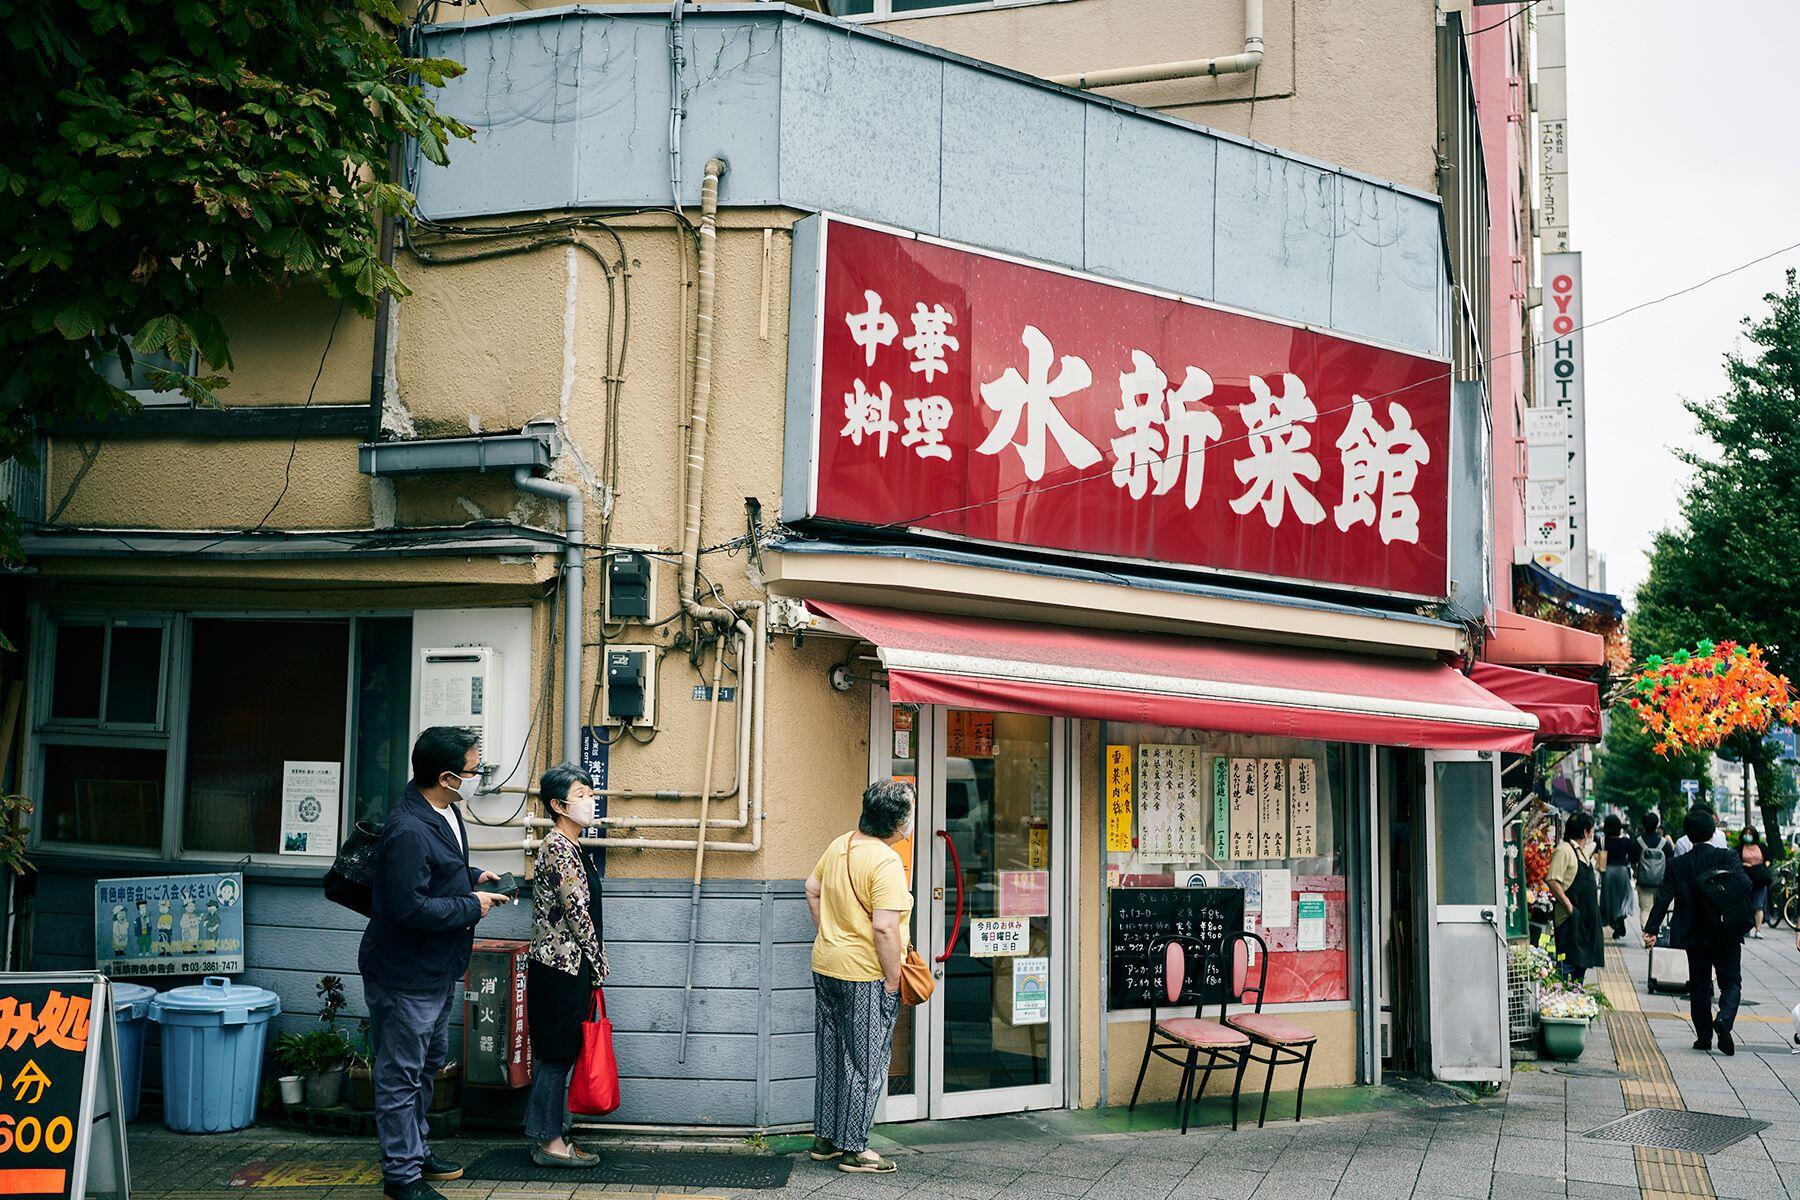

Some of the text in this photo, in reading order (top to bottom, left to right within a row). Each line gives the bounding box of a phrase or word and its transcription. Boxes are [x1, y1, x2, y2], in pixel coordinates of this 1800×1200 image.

[845, 289, 959, 383] 中華
[1552, 275, 1574, 334] OYO
[1554, 340, 1576, 420] HOT
[840, 378, 953, 461] 料理
[976, 325, 1431, 546] 水新菜館
[100, 884, 216, 904] 青色申告会にご入会ください
[977, 921, 1023, 931] 今月のお休み
[981, 931, 1020, 942] 毎日曜日と
[480, 976, 497, 1053] 消火器
[0, 1058, 53, 1104] 分
